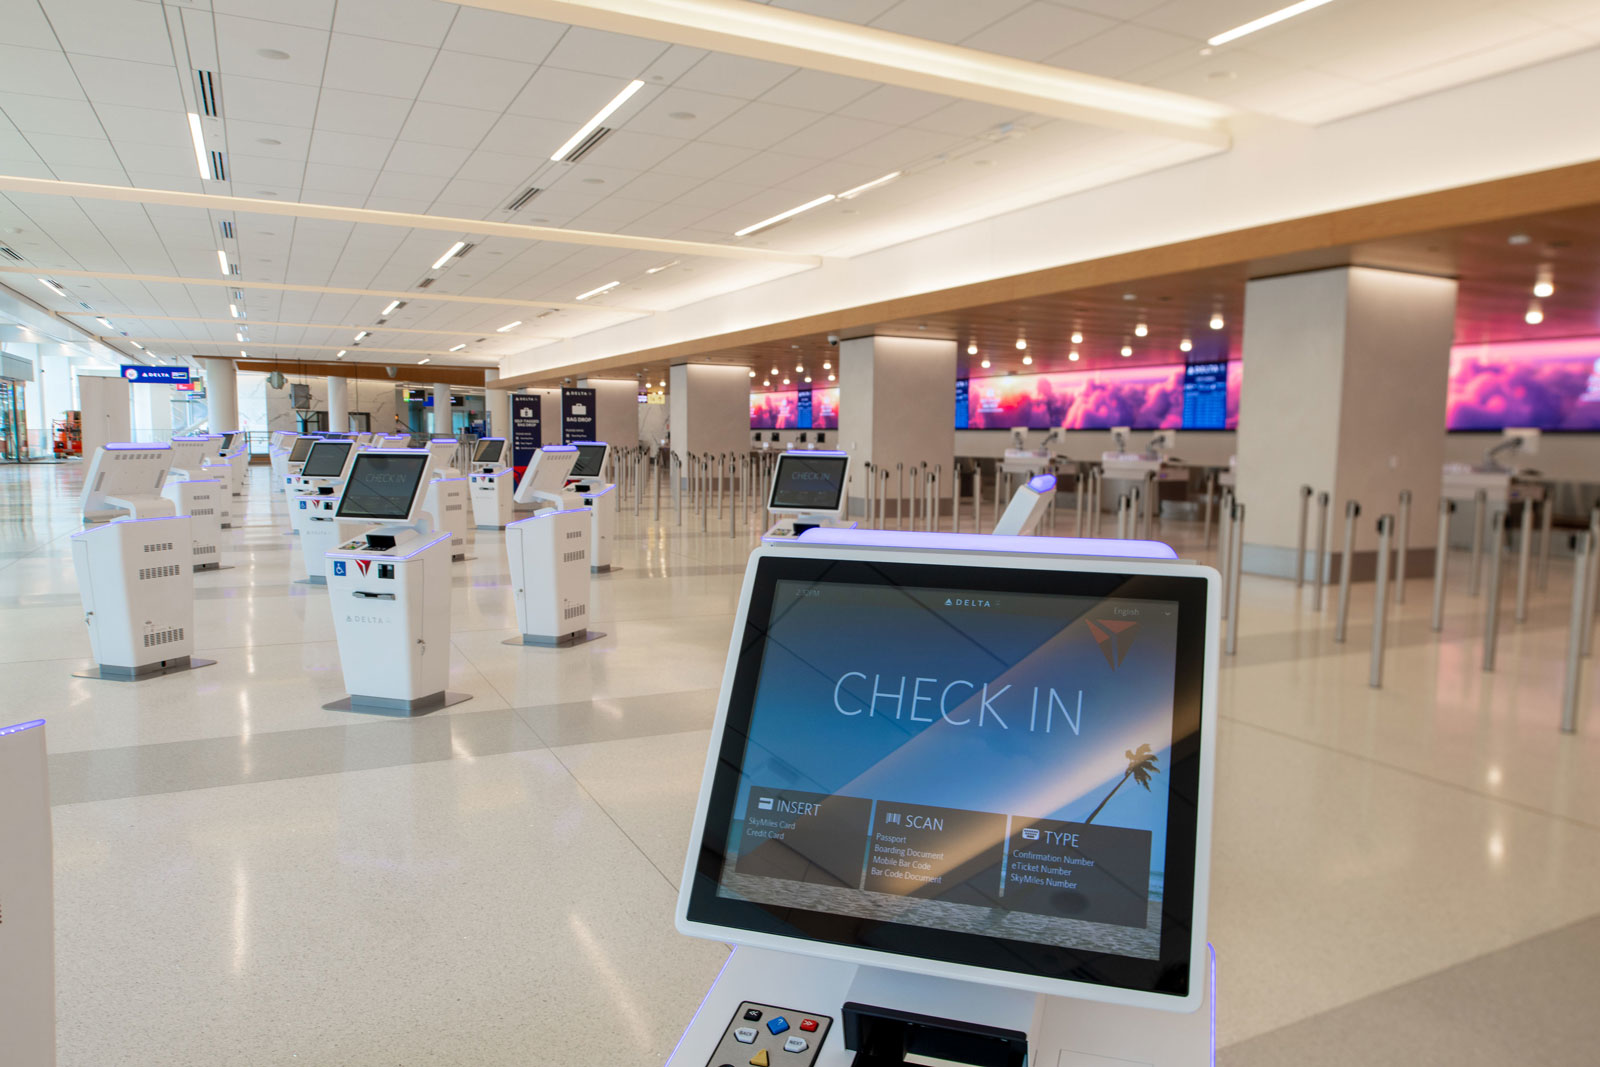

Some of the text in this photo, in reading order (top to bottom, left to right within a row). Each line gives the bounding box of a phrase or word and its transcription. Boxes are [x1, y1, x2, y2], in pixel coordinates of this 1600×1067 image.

[365, 473, 395, 483] CHECK
[791, 472, 831, 480] CHECK IN
[955, 599, 991, 607] DELTA
[1113, 607, 1140, 616] English
[354, 616, 384, 624] DELTA
[833, 671, 1083, 736] CHECK IN
[776, 800, 822, 816] INSERT
[748, 817, 796, 830] SkyMiles Card
[905, 814, 944, 832] SCAN
[746, 828, 785, 840] Credit Card
[875, 833, 907, 844] Passport
[1044, 830, 1080, 848] TYPE
[874, 844, 944, 860] Boarding Document
[1012, 849, 1095, 867] Confirmation Number
[872, 856, 932, 870] Mobile Bar Code
[1011, 862, 1072, 876] eTicket Number
[871, 867, 942, 884] Bar Code Document
[1010, 873, 1078, 889] SkyMiles Number
